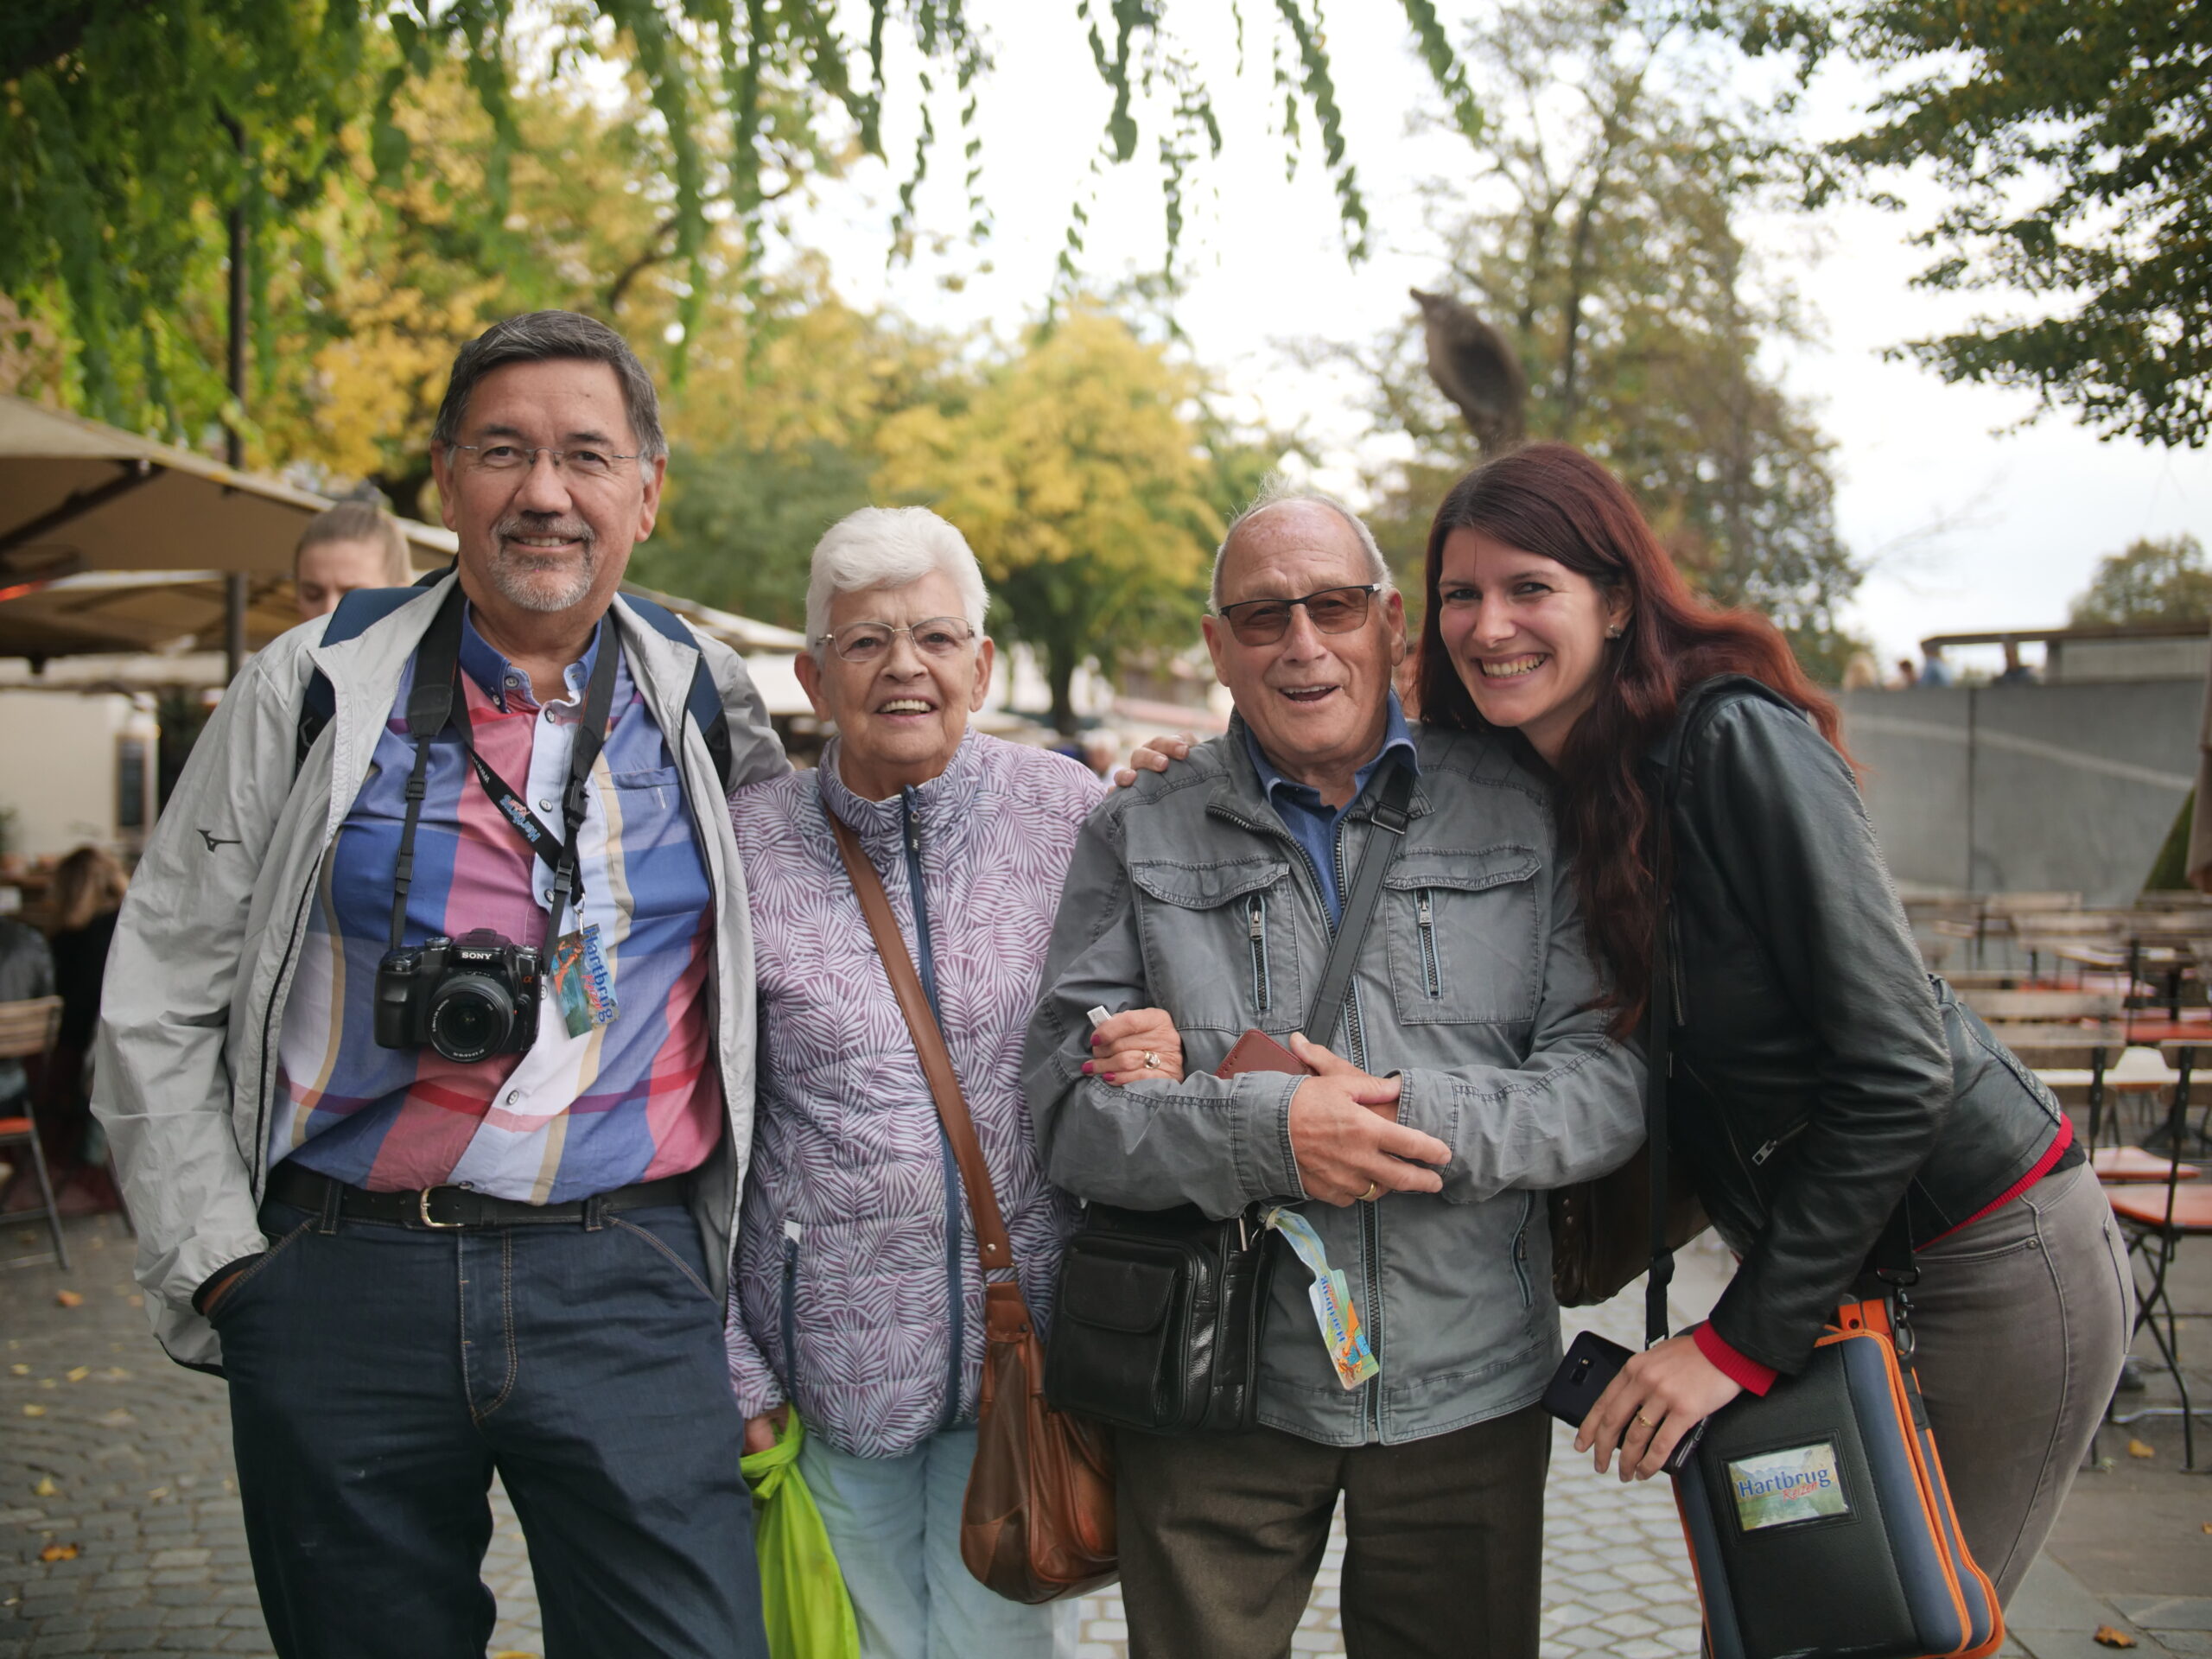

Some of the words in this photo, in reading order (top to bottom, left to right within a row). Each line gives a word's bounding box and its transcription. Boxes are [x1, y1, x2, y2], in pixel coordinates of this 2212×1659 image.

[461, 951, 493, 960] SONY
[580, 926, 613, 1023] Hartbrug
[1737, 1468, 1831, 1497] Hartbrug
[1782, 1481, 1819, 1503] Reizen
